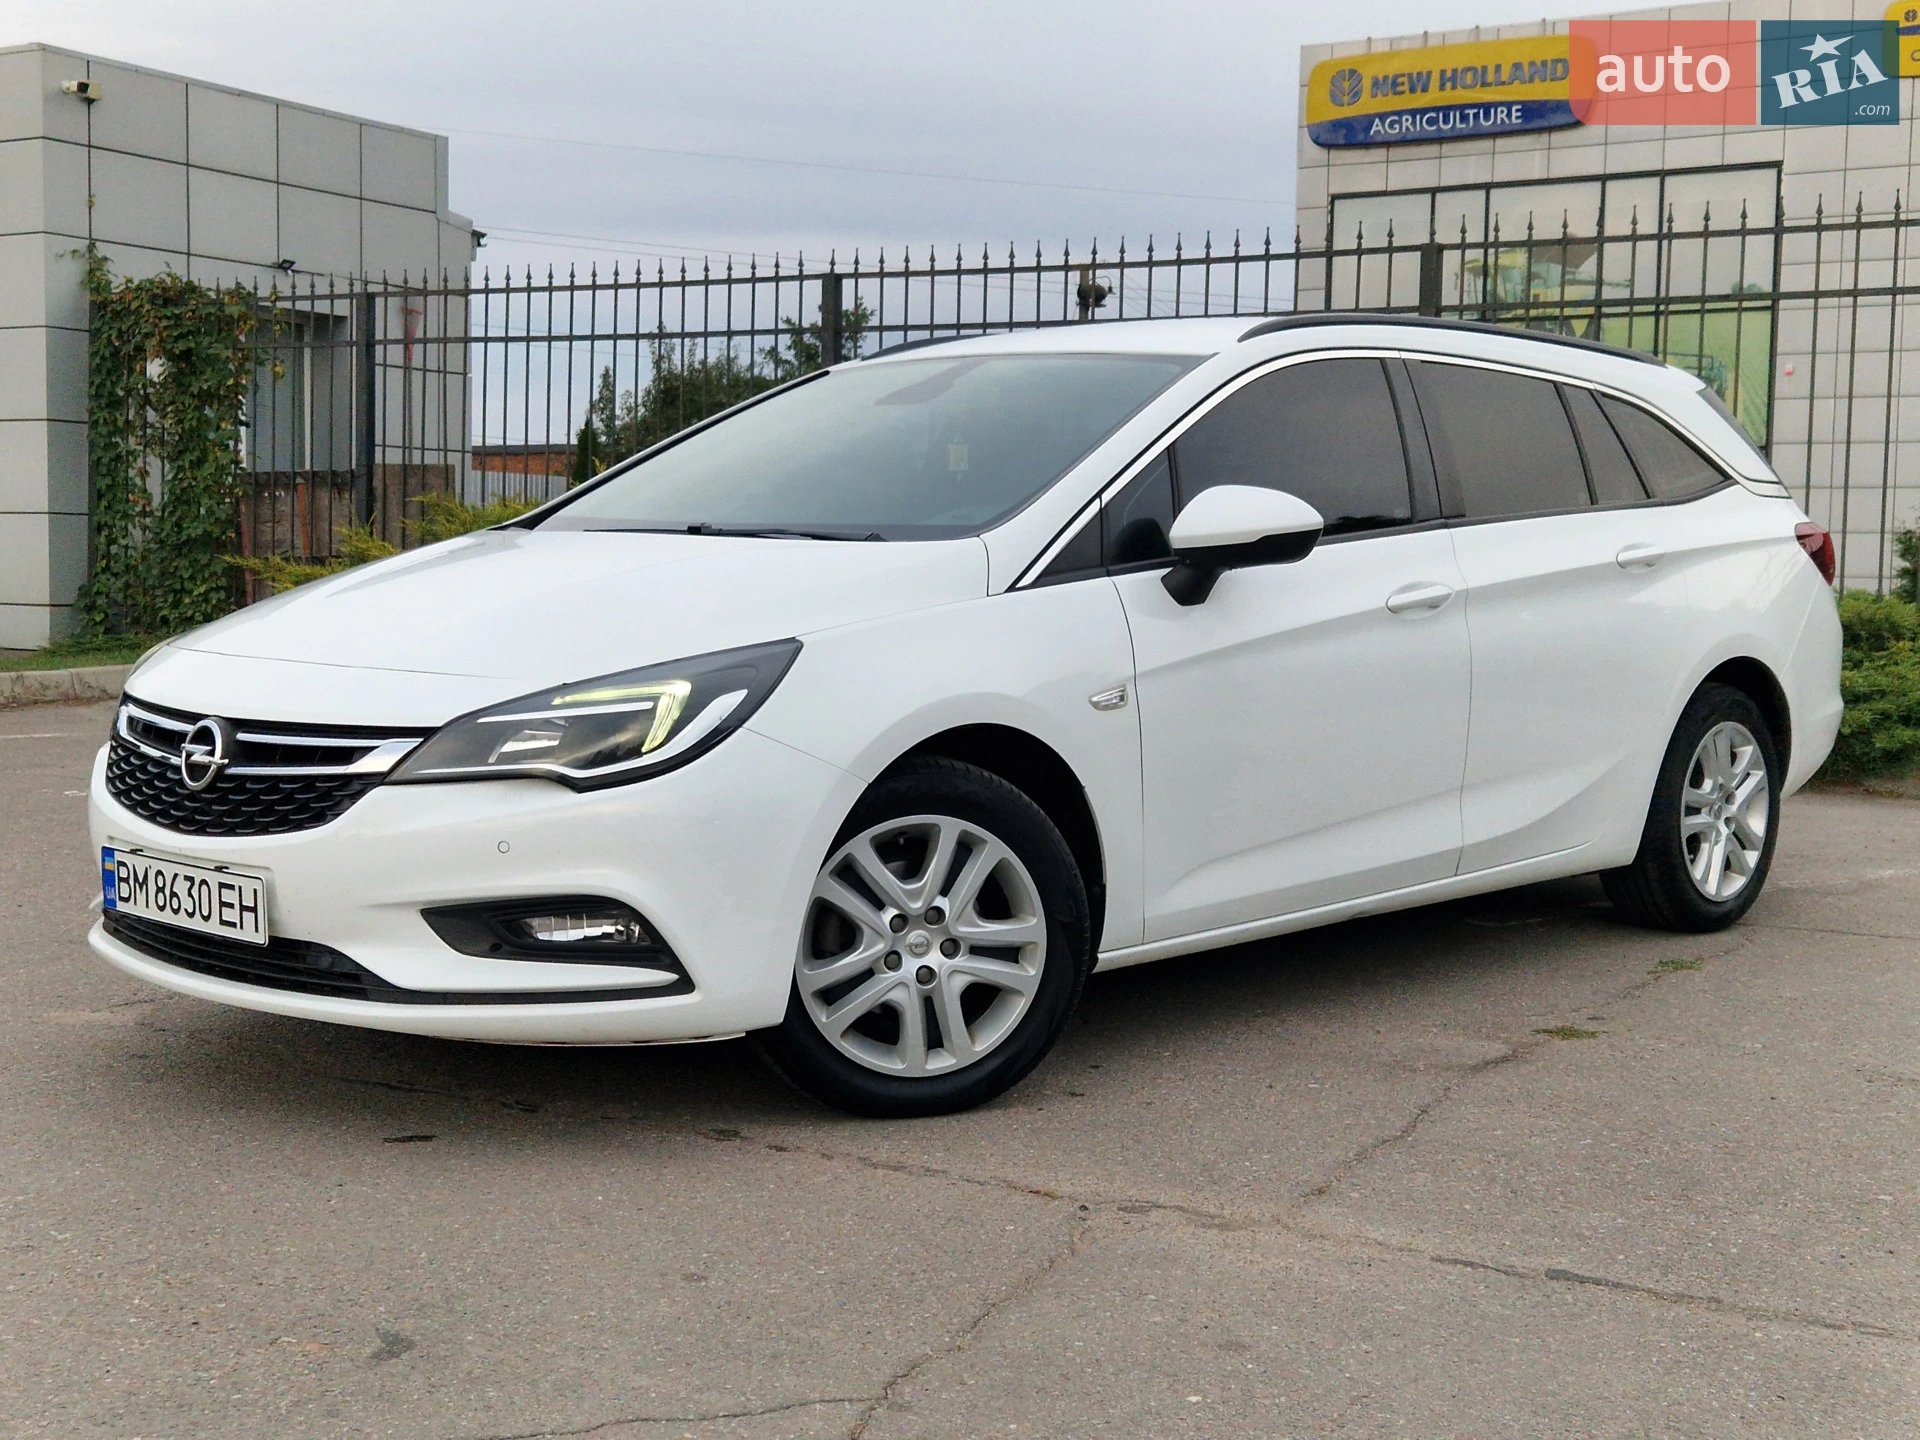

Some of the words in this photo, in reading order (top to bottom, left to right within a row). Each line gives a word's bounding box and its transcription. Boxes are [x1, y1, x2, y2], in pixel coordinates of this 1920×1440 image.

[1370, 70, 1432, 98] NEW
[1438, 58, 1569, 91] HOLLAND
[1370, 105, 1523, 136] AGRICULTURE
[105, 885, 117, 900] UA
